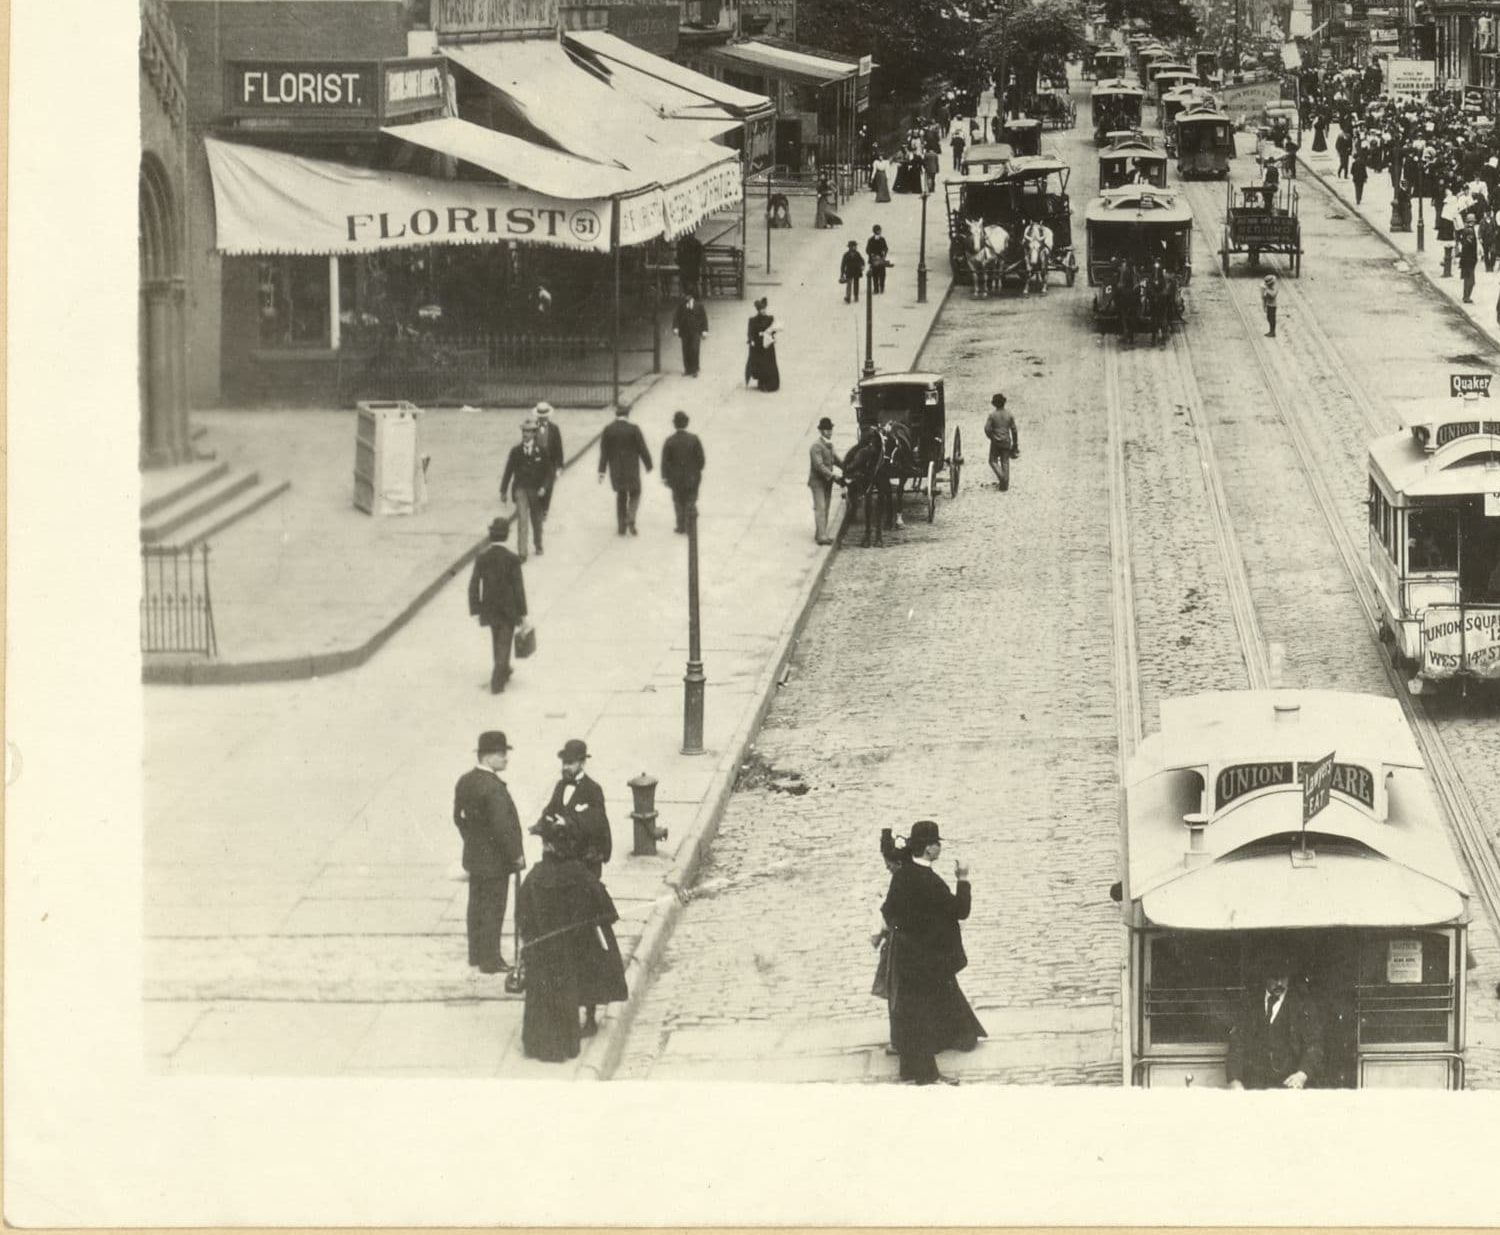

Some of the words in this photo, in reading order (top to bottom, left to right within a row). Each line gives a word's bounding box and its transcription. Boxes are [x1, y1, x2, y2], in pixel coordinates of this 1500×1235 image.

[346, 207, 567, 242] FLORIST
[574, 216, 596, 235] 51
[1453, 376, 1490, 391] Quaker
[1439, 423, 1475, 444] UNION
[1426, 620, 1463, 642] UNION
[1429, 650, 1463, 667] WEST
[1221, 763, 1285, 802] UNION
